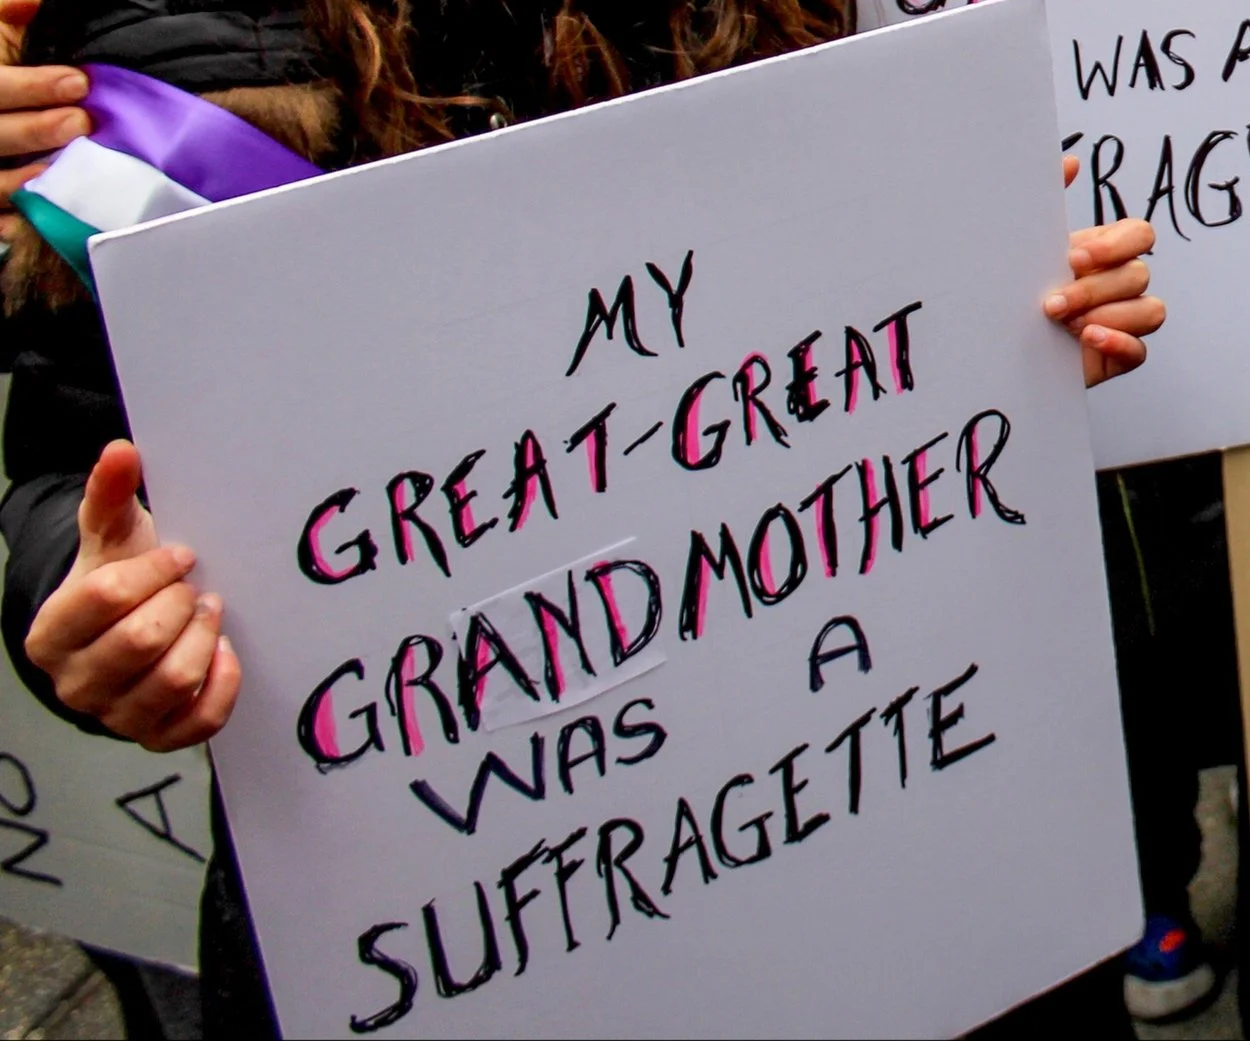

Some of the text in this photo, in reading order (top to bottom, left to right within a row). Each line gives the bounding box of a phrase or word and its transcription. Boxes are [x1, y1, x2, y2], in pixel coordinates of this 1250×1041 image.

[1074, 29, 1196, 100] WAS
[566, 250, 694, 376] MY
[297, 301, 923, 585] GREAT-GREAT
[297, 409, 1026, 775] GRANDMOTHER
[808, 615, 872, 692] A
[409, 698, 668, 836] WAS
[349, 663, 997, 1035] SUFFRAGETTE
